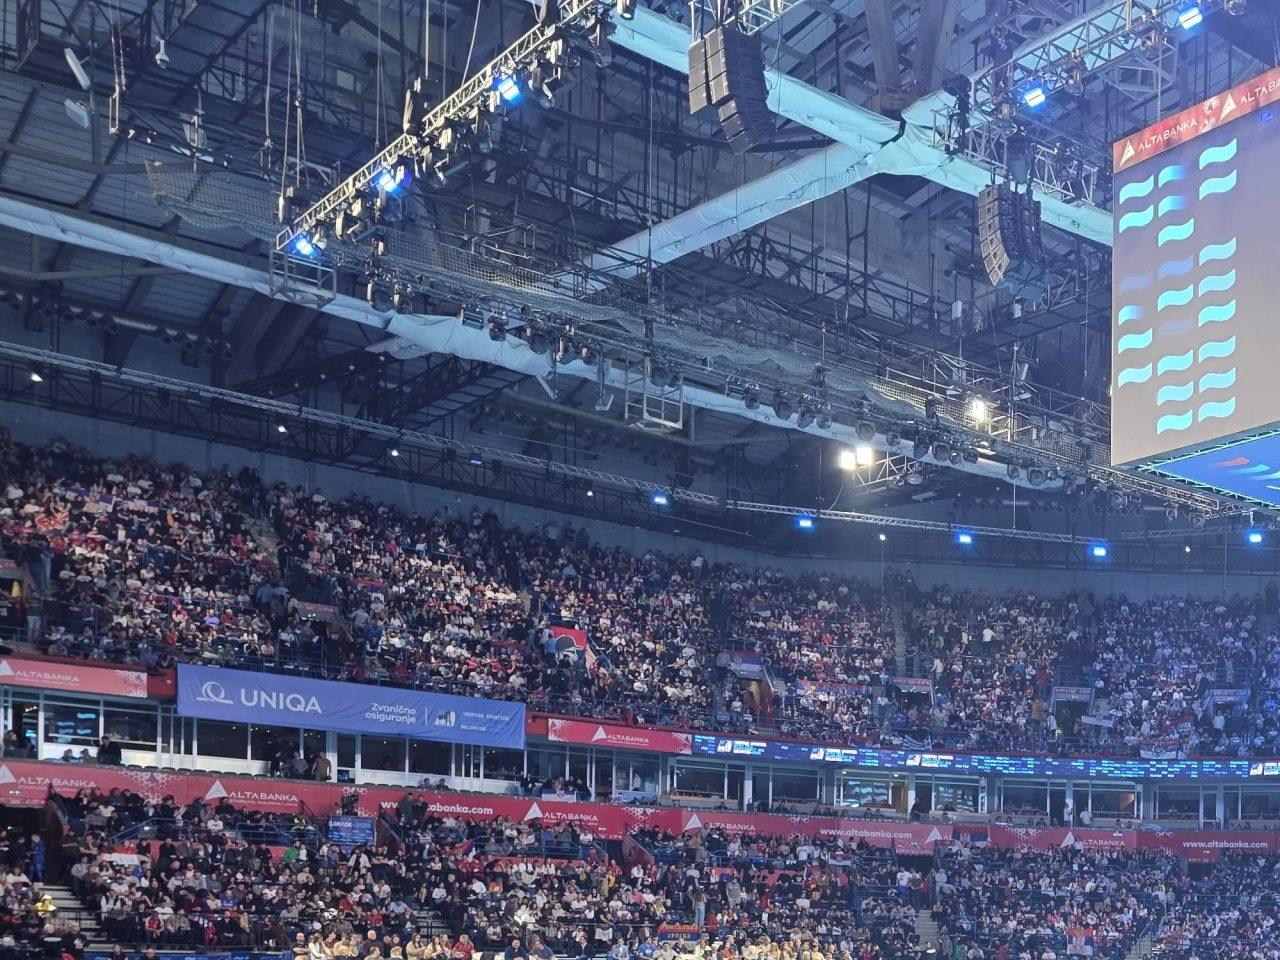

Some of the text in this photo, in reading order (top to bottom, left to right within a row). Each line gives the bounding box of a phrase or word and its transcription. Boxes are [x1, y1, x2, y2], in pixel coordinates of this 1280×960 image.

[1138, 117, 1198, 153] ALTABANKA
[15, 670, 80, 682] ALTABANKA
[240, 688, 323, 714] UNIQA
[371, 702, 416, 715] Zvanično
[365, 711, 416, 725] osiguranje
[607, 734, 650, 743] ALTABANKA
[18, 776, 97, 788] ALTABANKA
[229, 791, 298, 802] ALTABANKA
[543, 811, 599, 822] ALTABANKA
[709, 822, 756, 831] LTABANKA
[820, 827, 912, 839] www.altabanka.com
[1083, 839, 1125, 847] LTABANKA
[1183, 839, 1268, 849] www.altabanka.com
